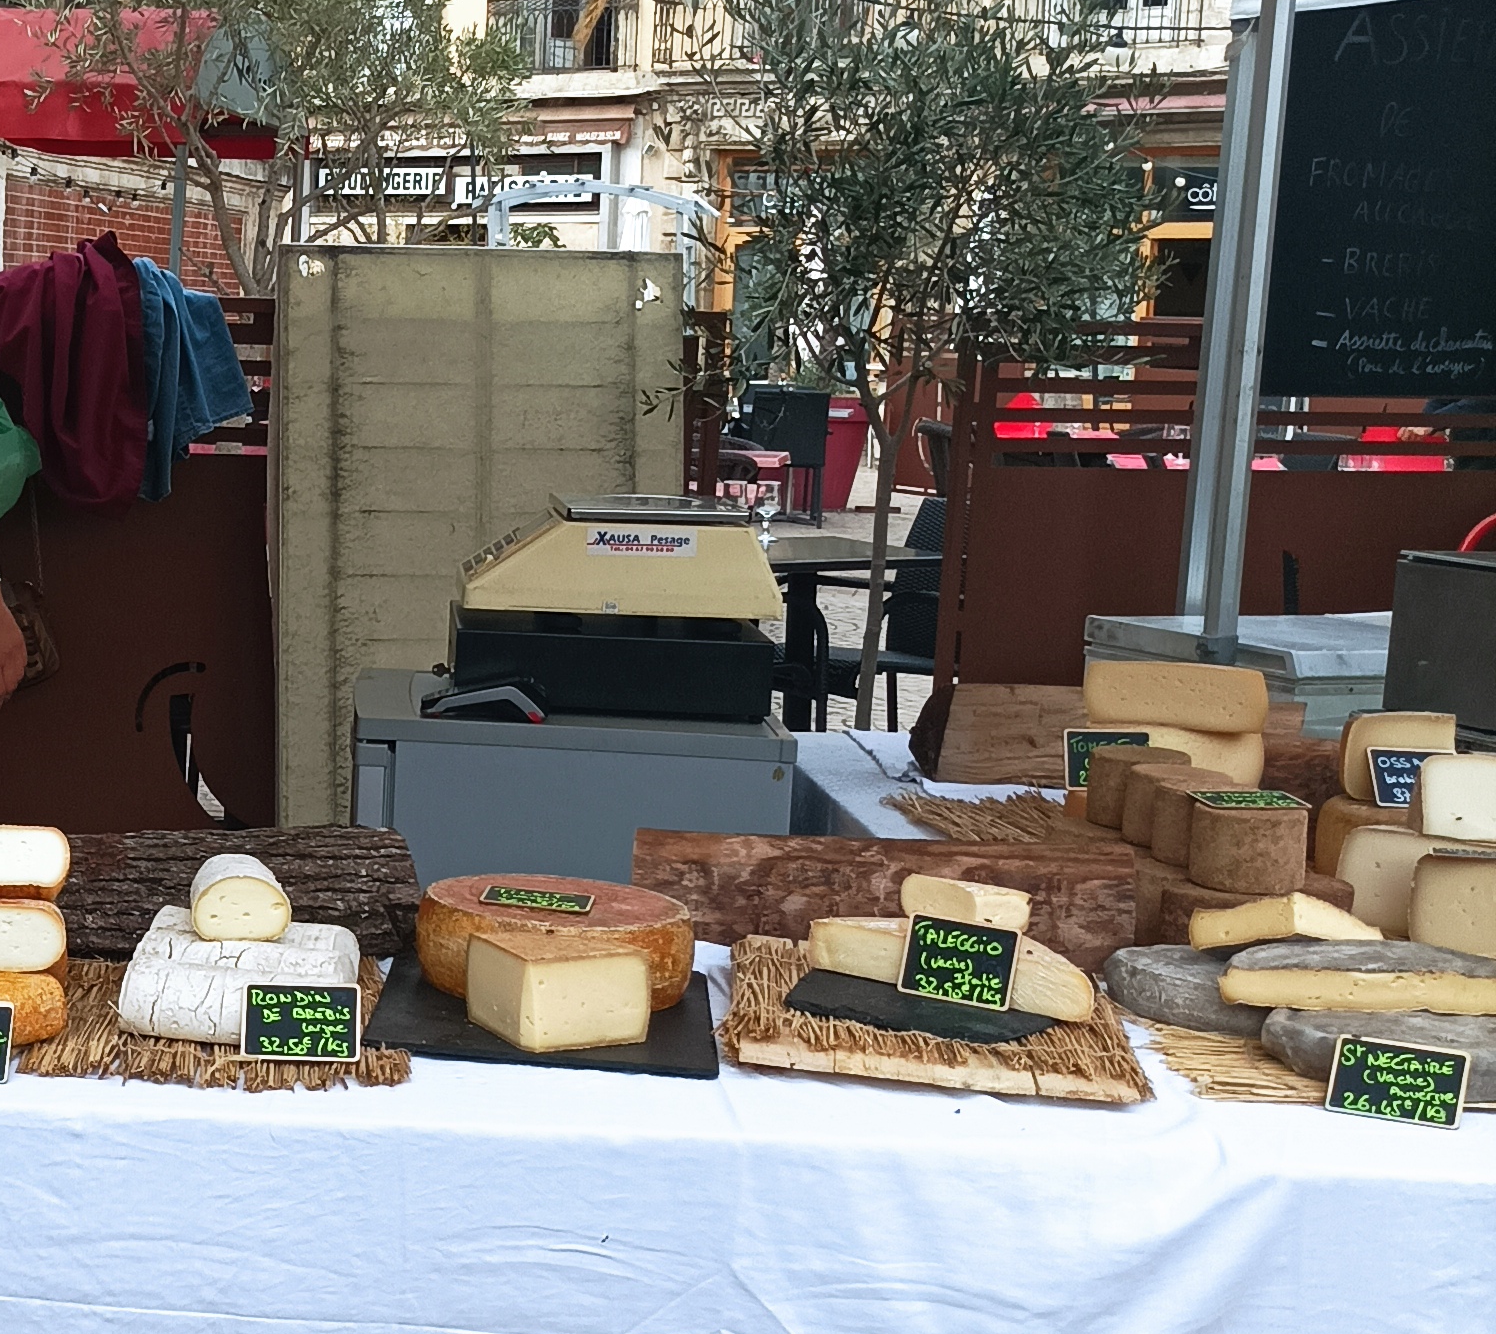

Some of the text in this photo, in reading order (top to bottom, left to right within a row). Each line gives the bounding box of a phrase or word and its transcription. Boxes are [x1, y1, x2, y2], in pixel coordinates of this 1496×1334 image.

[325, 172, 441, 191] BULNGERIE
[1345, 297, 1431, 322] VACHE
[1335, 329, 1406, 351] Assiette
[596, 531, 691, 547] XAUSA Pesage
[263, 1008, 282, 1022] DE
